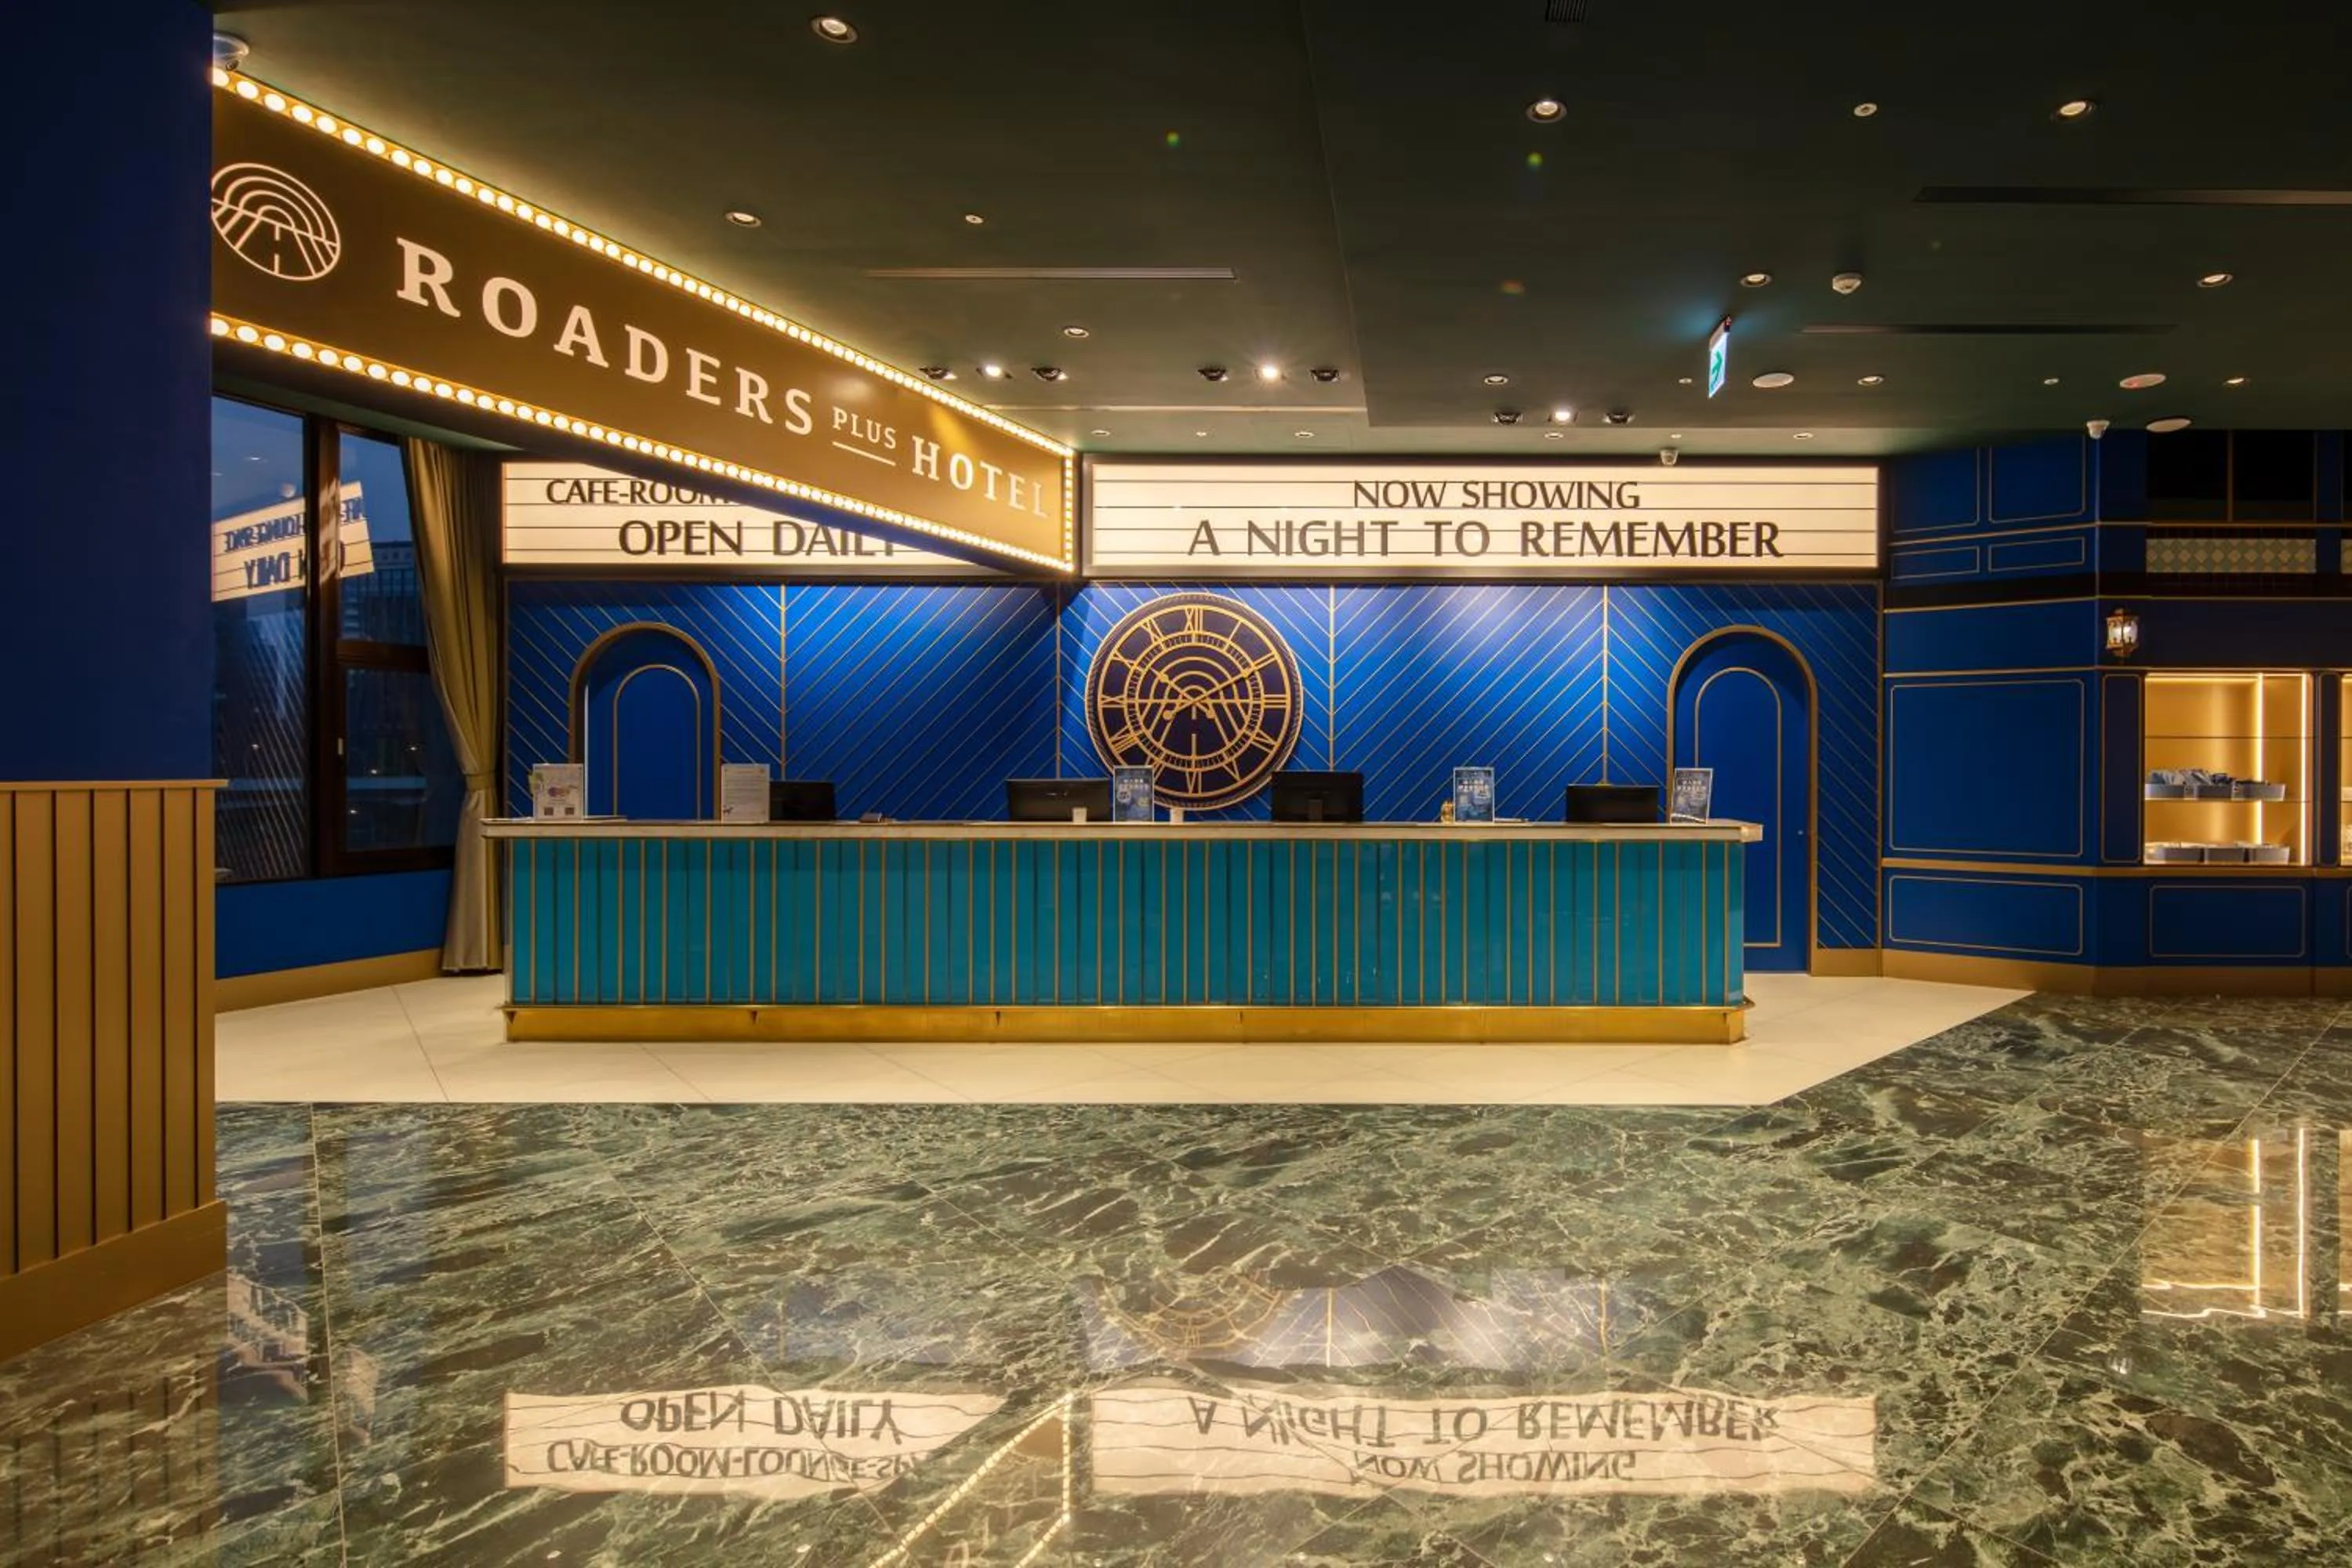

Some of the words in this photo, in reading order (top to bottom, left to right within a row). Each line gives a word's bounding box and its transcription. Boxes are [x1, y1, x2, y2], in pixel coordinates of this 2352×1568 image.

[395, 237, 814, 436] ROADERS
[832, 406, 897, 449] PLUS
[912, 435, 1048, 519] HOTEL
[546, 478, 729, 504] CAFE-ROO
[1354, 480, 1447, 509] NOW
[1461, 480, 1641, 509] SHOWING
[619, 520, 743, 556] OPEN
[1188, 519, 1221, 556] A
[1247, 520, 1399, 557] NIGHT
[1424, 520, 1490, 557] TO
[1521, 521, 1784, 557] REMEMBER
